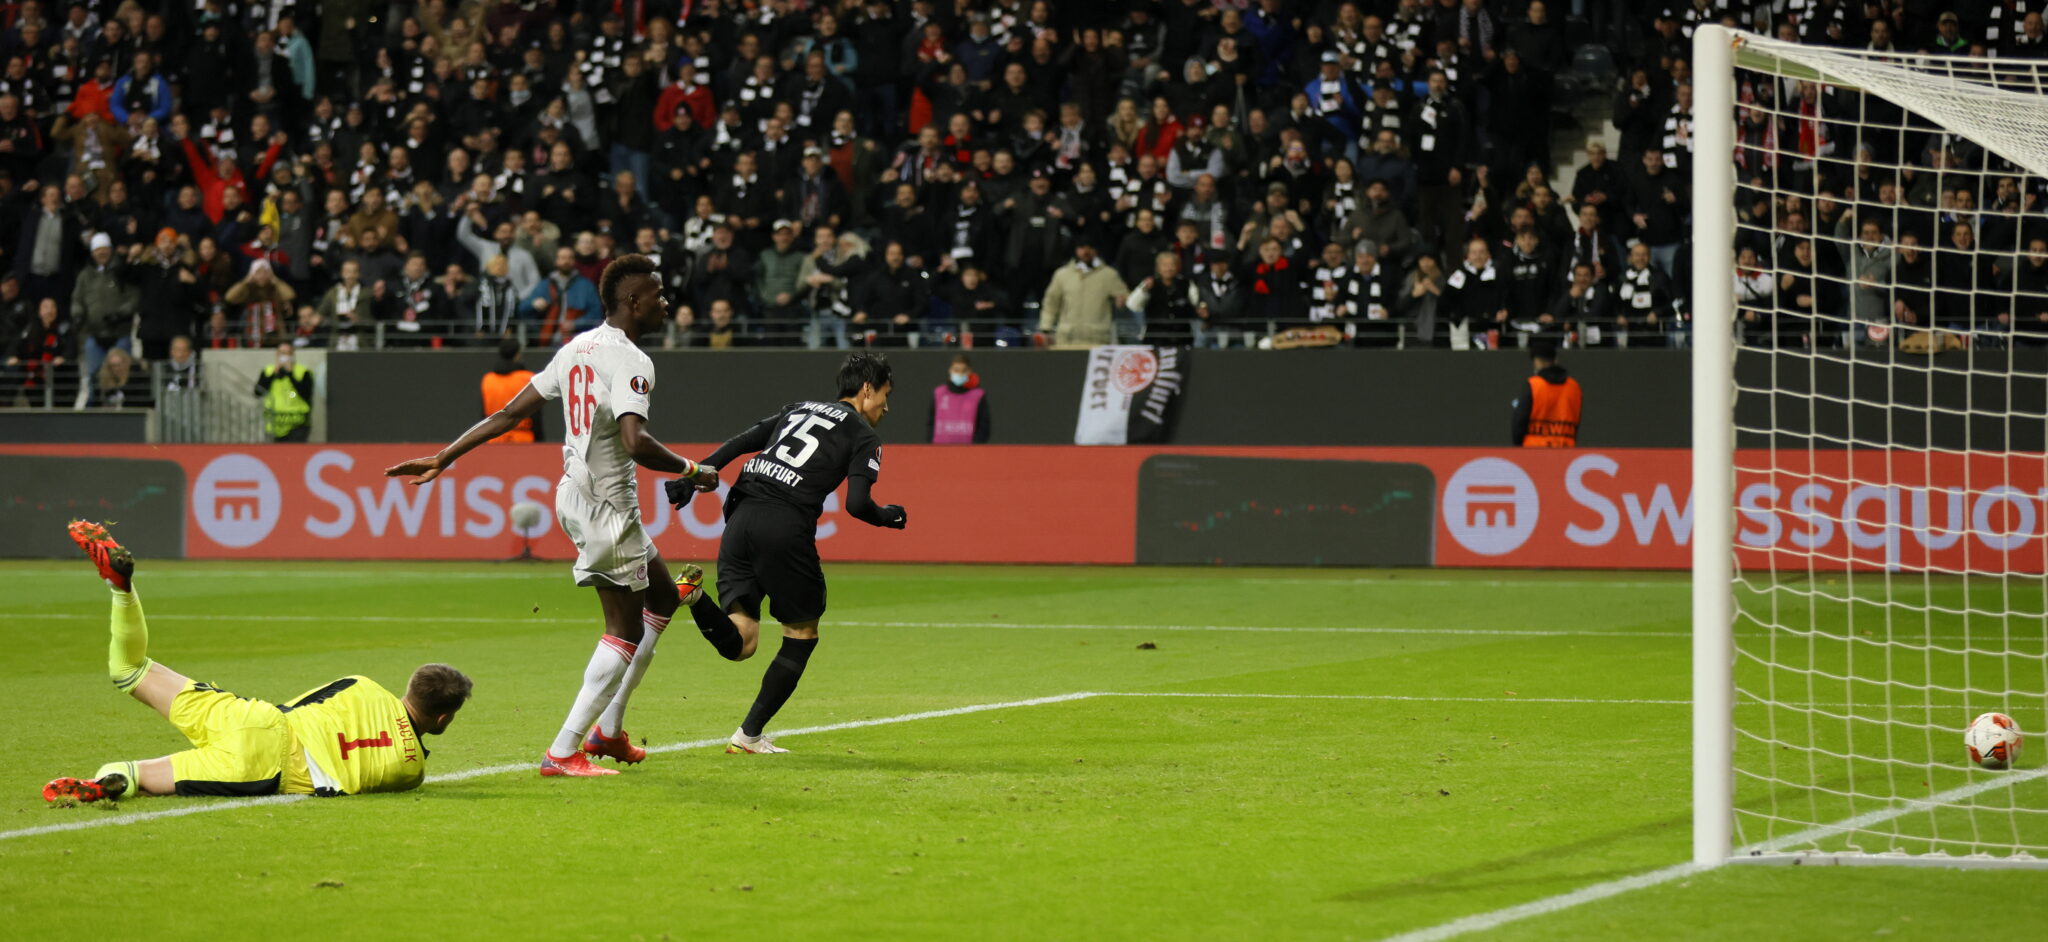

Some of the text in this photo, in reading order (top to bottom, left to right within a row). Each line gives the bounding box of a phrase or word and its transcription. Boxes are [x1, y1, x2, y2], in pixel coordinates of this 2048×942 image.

[568, 364, 598, 436] 66
[801, 402, 849, 422] YAMADA
[762, 413, 836, 468] 15
[1564, 453, 2048, 572] Swssquo
[337, 730, 393, 760] 1
